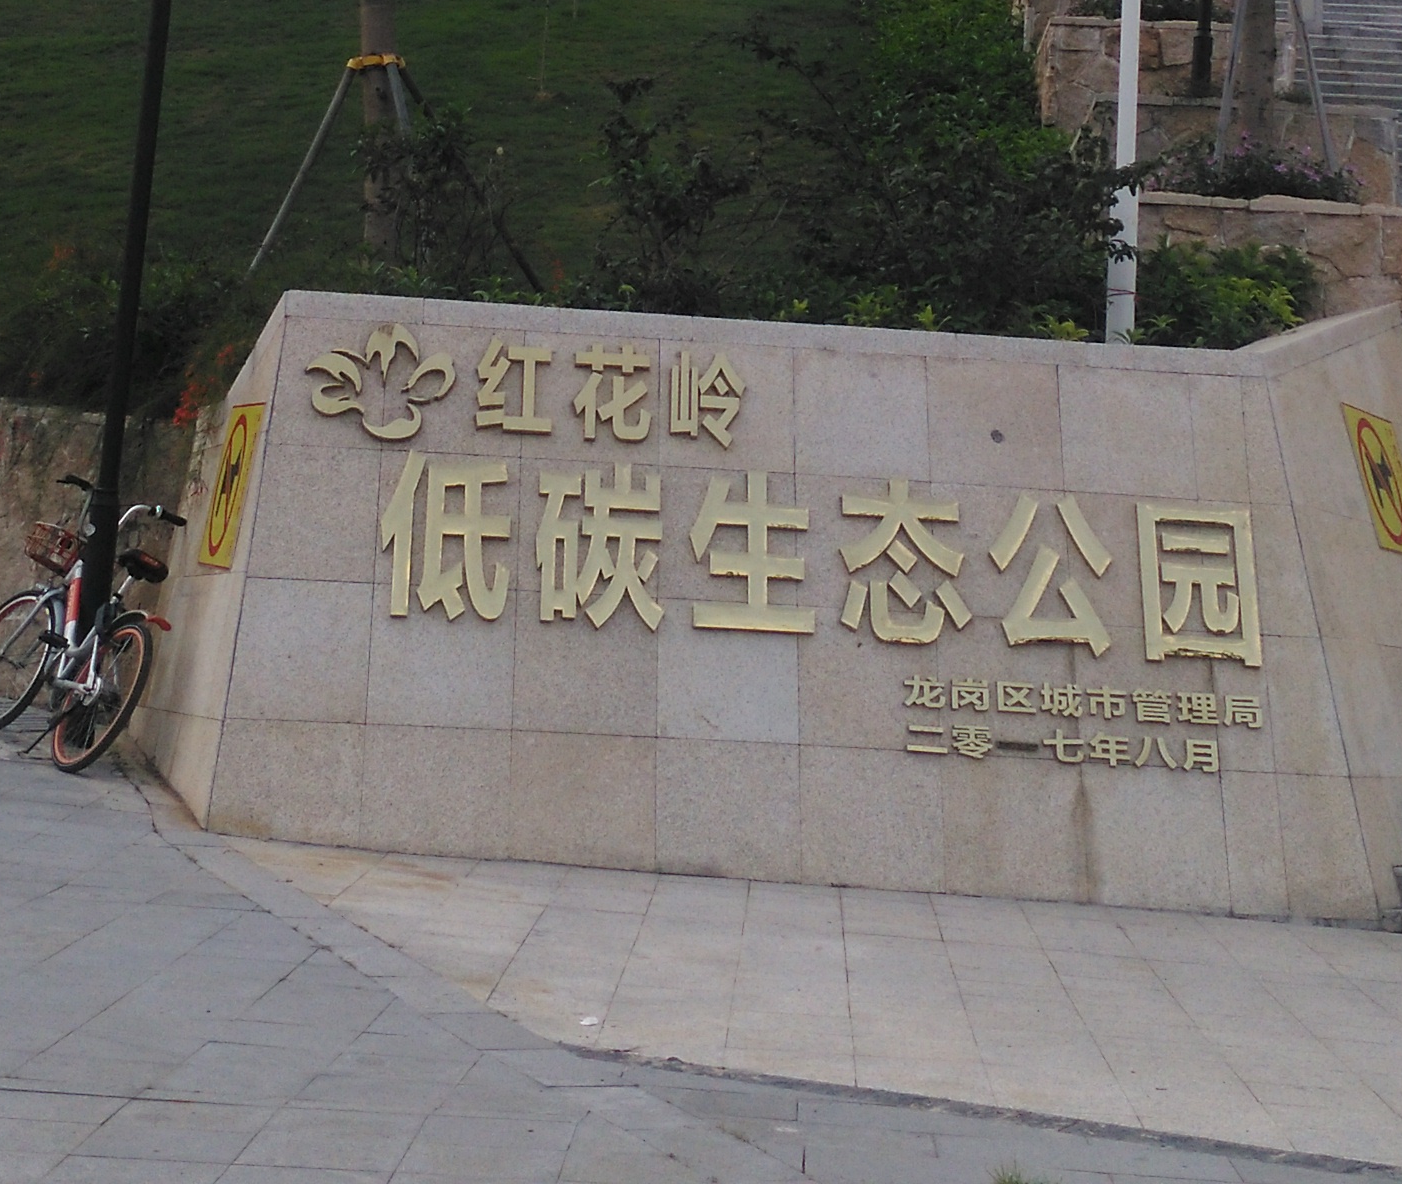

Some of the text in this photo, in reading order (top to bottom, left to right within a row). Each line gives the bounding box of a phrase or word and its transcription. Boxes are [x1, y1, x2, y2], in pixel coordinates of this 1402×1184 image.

[476, 336, 746, 449] 红花岭
[381, 450, 1262, 667] 低碳生态公园
[903, 674, 1264, 729] 龙岗区城市管理局
